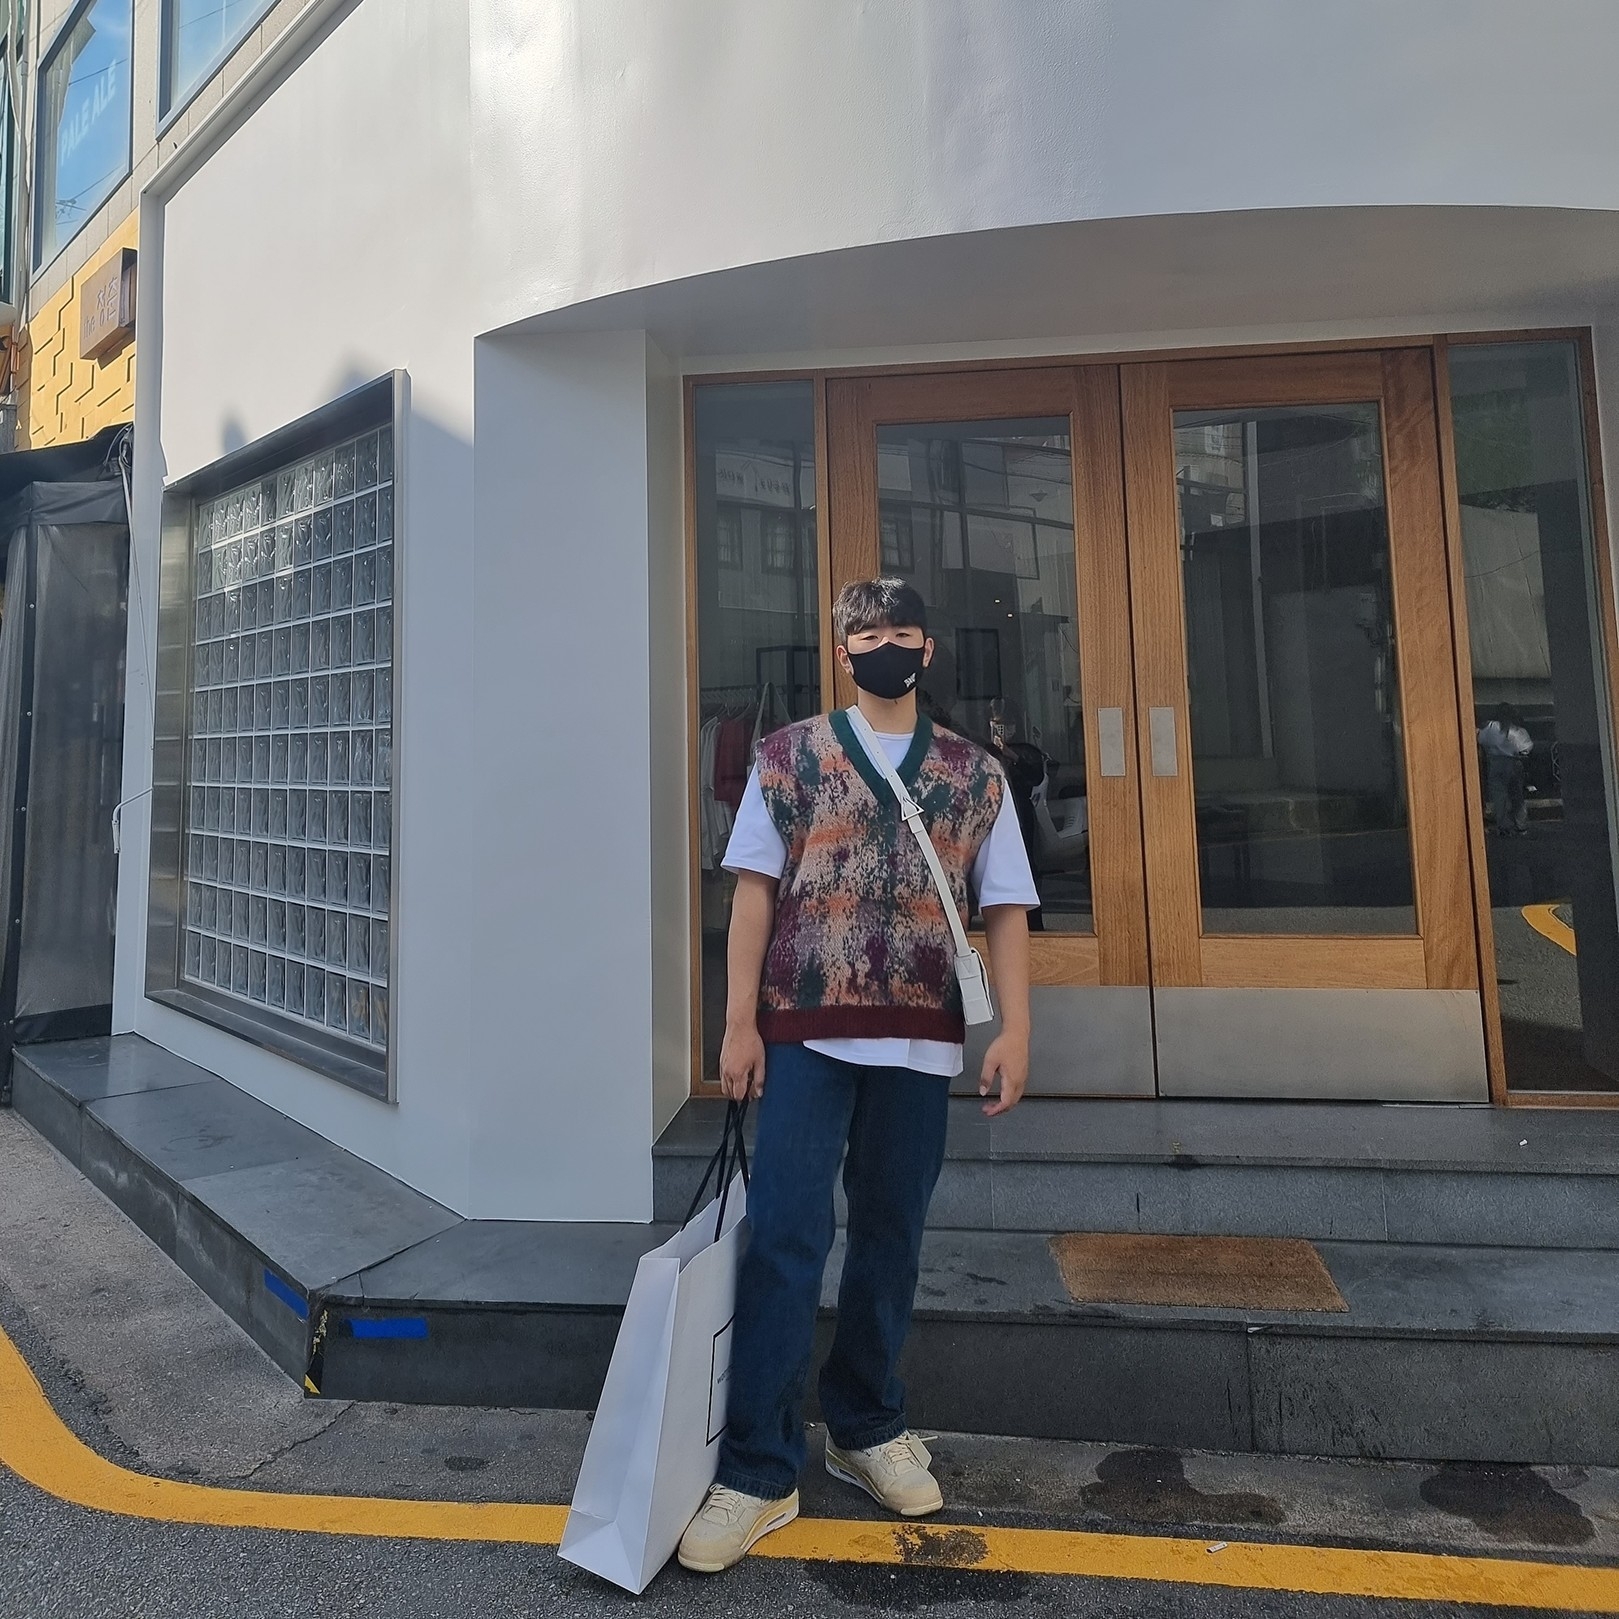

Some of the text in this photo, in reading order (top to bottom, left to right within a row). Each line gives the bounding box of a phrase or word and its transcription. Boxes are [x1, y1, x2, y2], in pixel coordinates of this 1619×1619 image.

[61, 58, 116, 167] PALE ALE
[97, 276, 118, 327] 청춘
